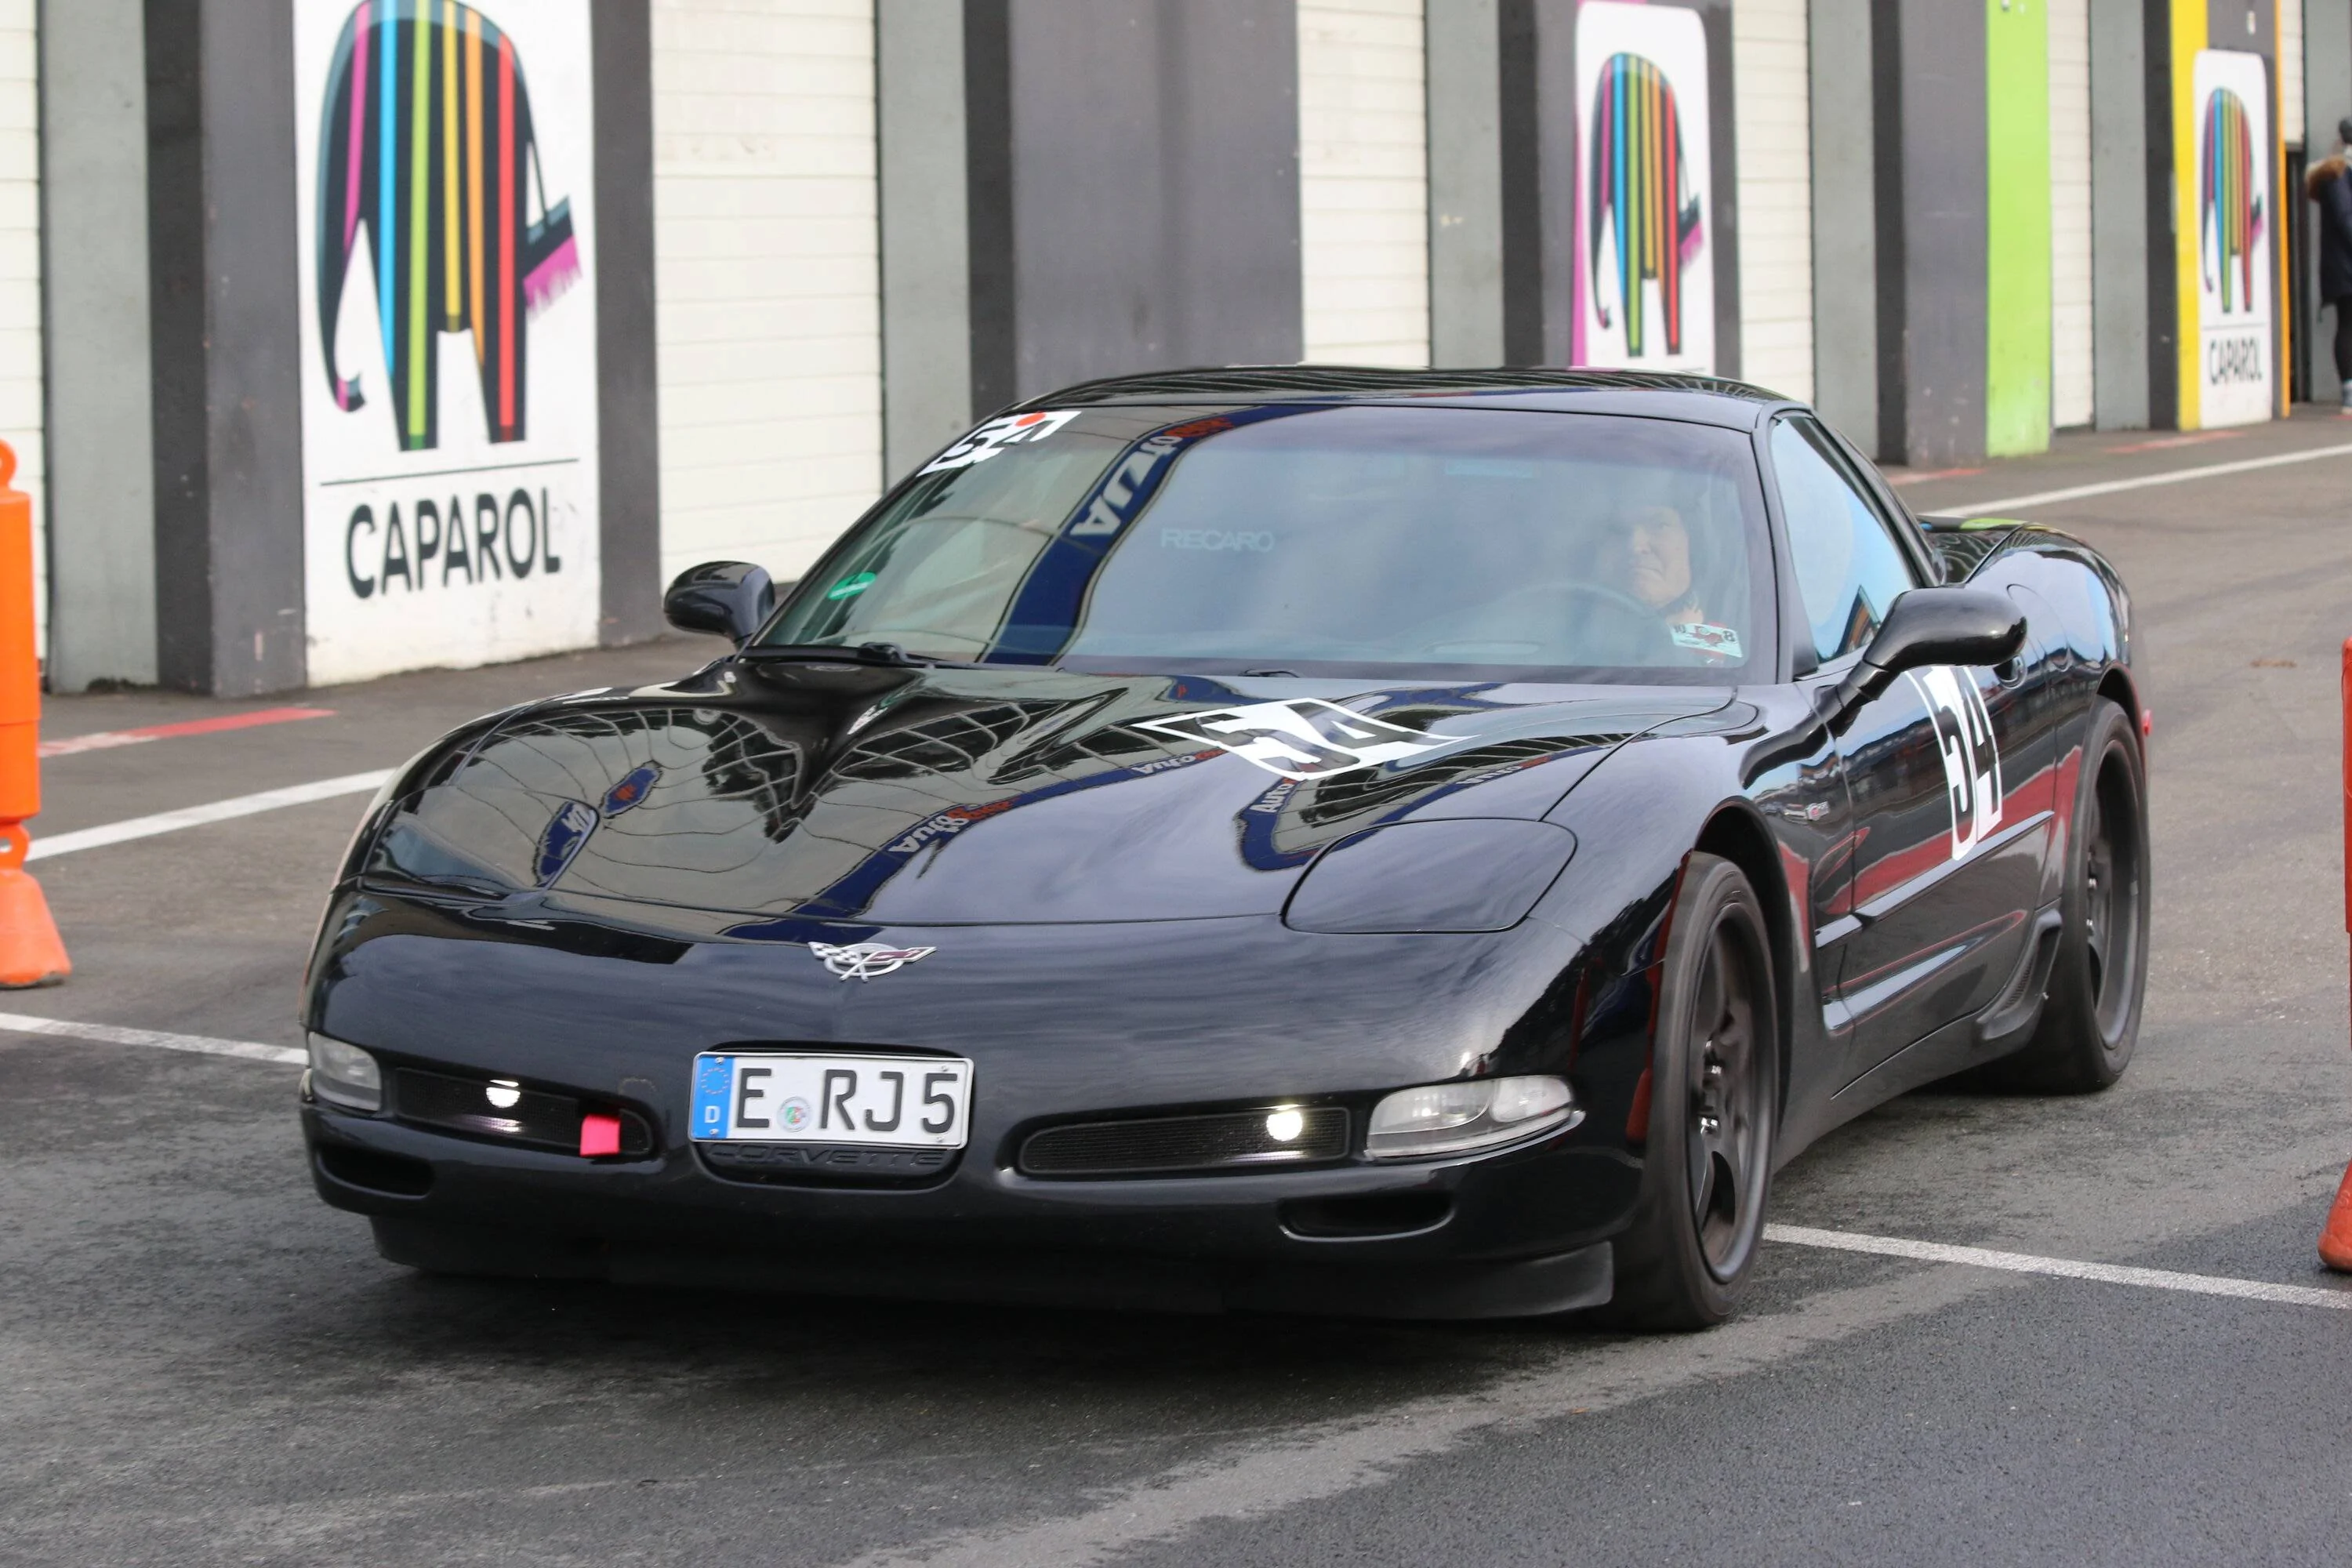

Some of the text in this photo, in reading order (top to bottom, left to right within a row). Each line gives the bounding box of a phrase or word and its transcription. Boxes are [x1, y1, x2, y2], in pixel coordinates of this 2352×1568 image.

[2209, 337, 2263, 385] CAPAROL
[346, 486, 561, 599] CAPAROL
[1160, 528, 1276, 553] RECARO
[704, 1105, 721, 1124] D
[735, 1067, 772, 1129] E
[709, 1142, 943, 1167] CORVETTE
